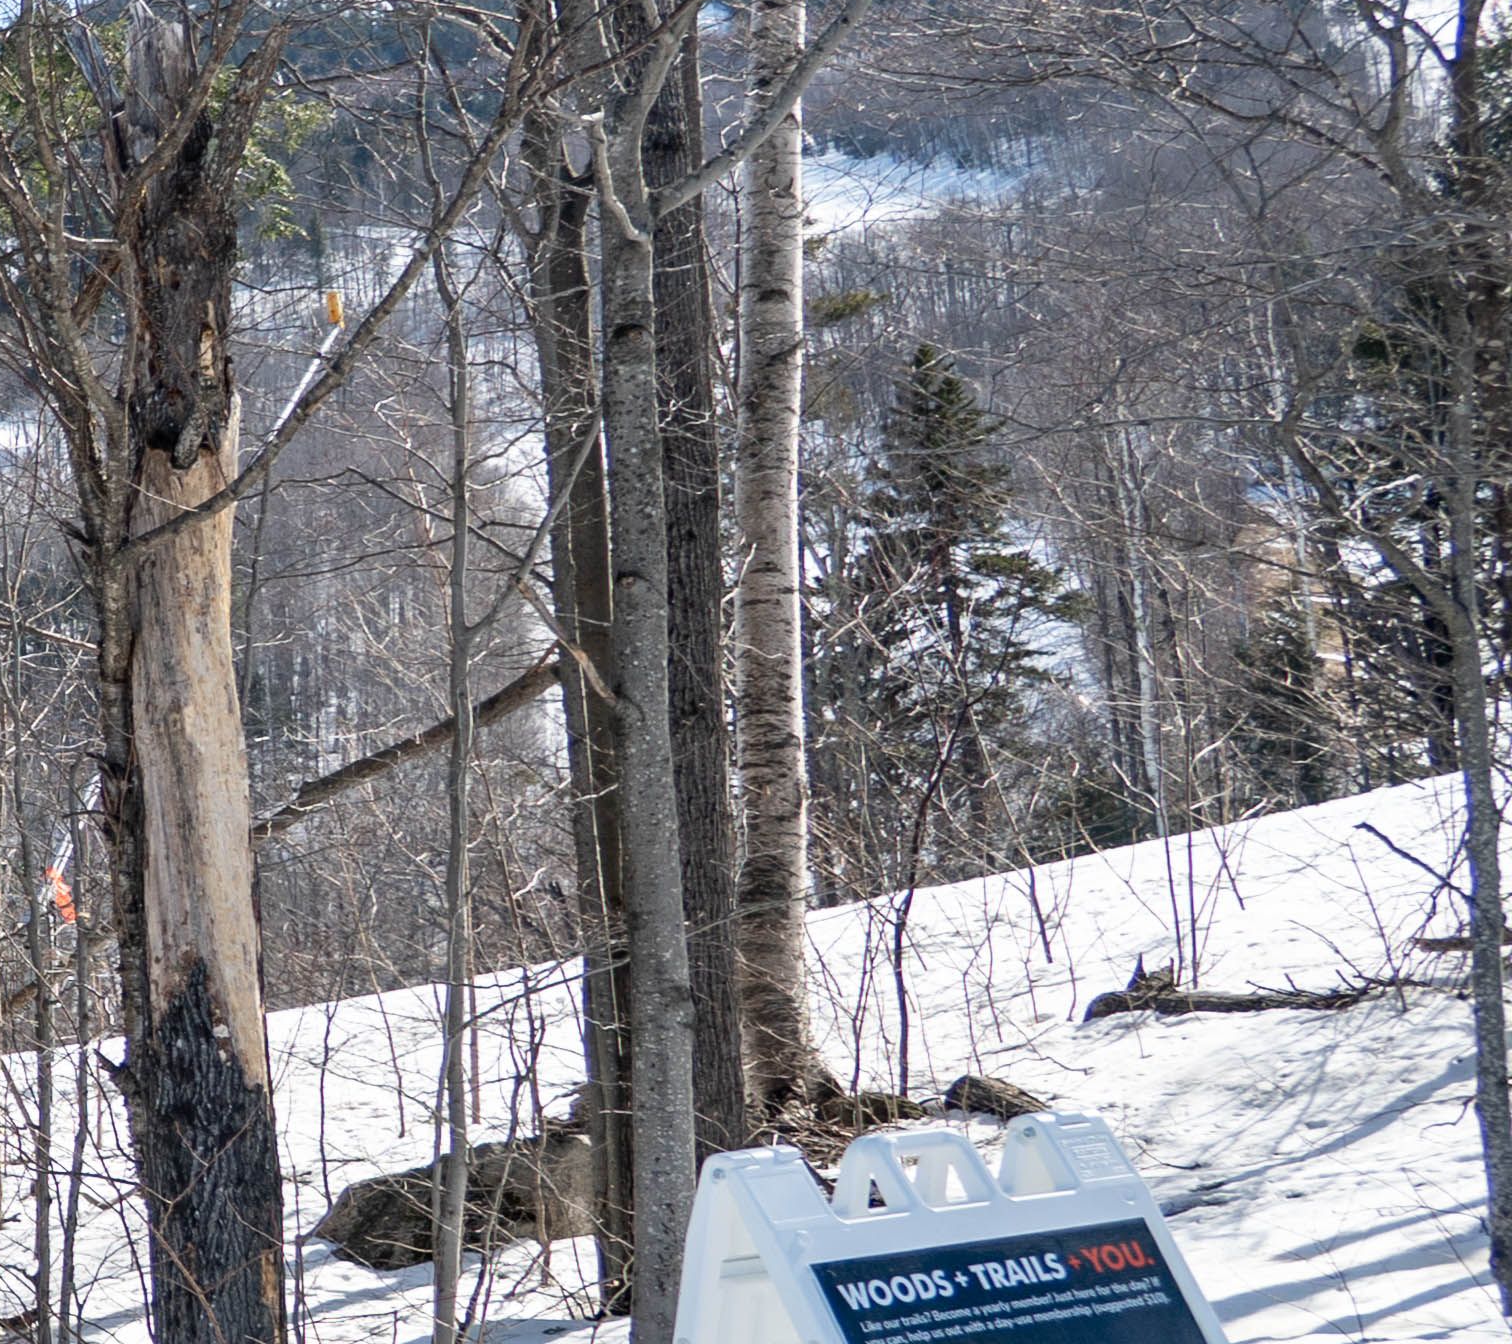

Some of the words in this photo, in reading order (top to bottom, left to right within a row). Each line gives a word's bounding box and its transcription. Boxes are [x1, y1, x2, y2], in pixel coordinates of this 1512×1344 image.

[837, 1269, 954, 1310] WOODS
[967, 1252, 1068, 1291] TRAILS
[1080, 1240, 1155, 1273] YOU.
[859, 1320, 883, 1333] Like
[883, 1317, 901, 1329] our
[901, 1312, 932, 1328] trails?
[932, 1307, 971, 1322] Become
[980, 1301, 1011, 1316] yearly
[1072, 1287, 1097, 1300] here
[1095, 1284, 1111, 1297] for
[1111, 1282, 1129, 1294] the
[907, 1329, 931, 1344] help
[931, 1327, 945, 1338] us
[945, 1324, 963, 1336] out
[963, 1320, 986, 1334] with
[1033, 1304, 1094, 1323] membership
